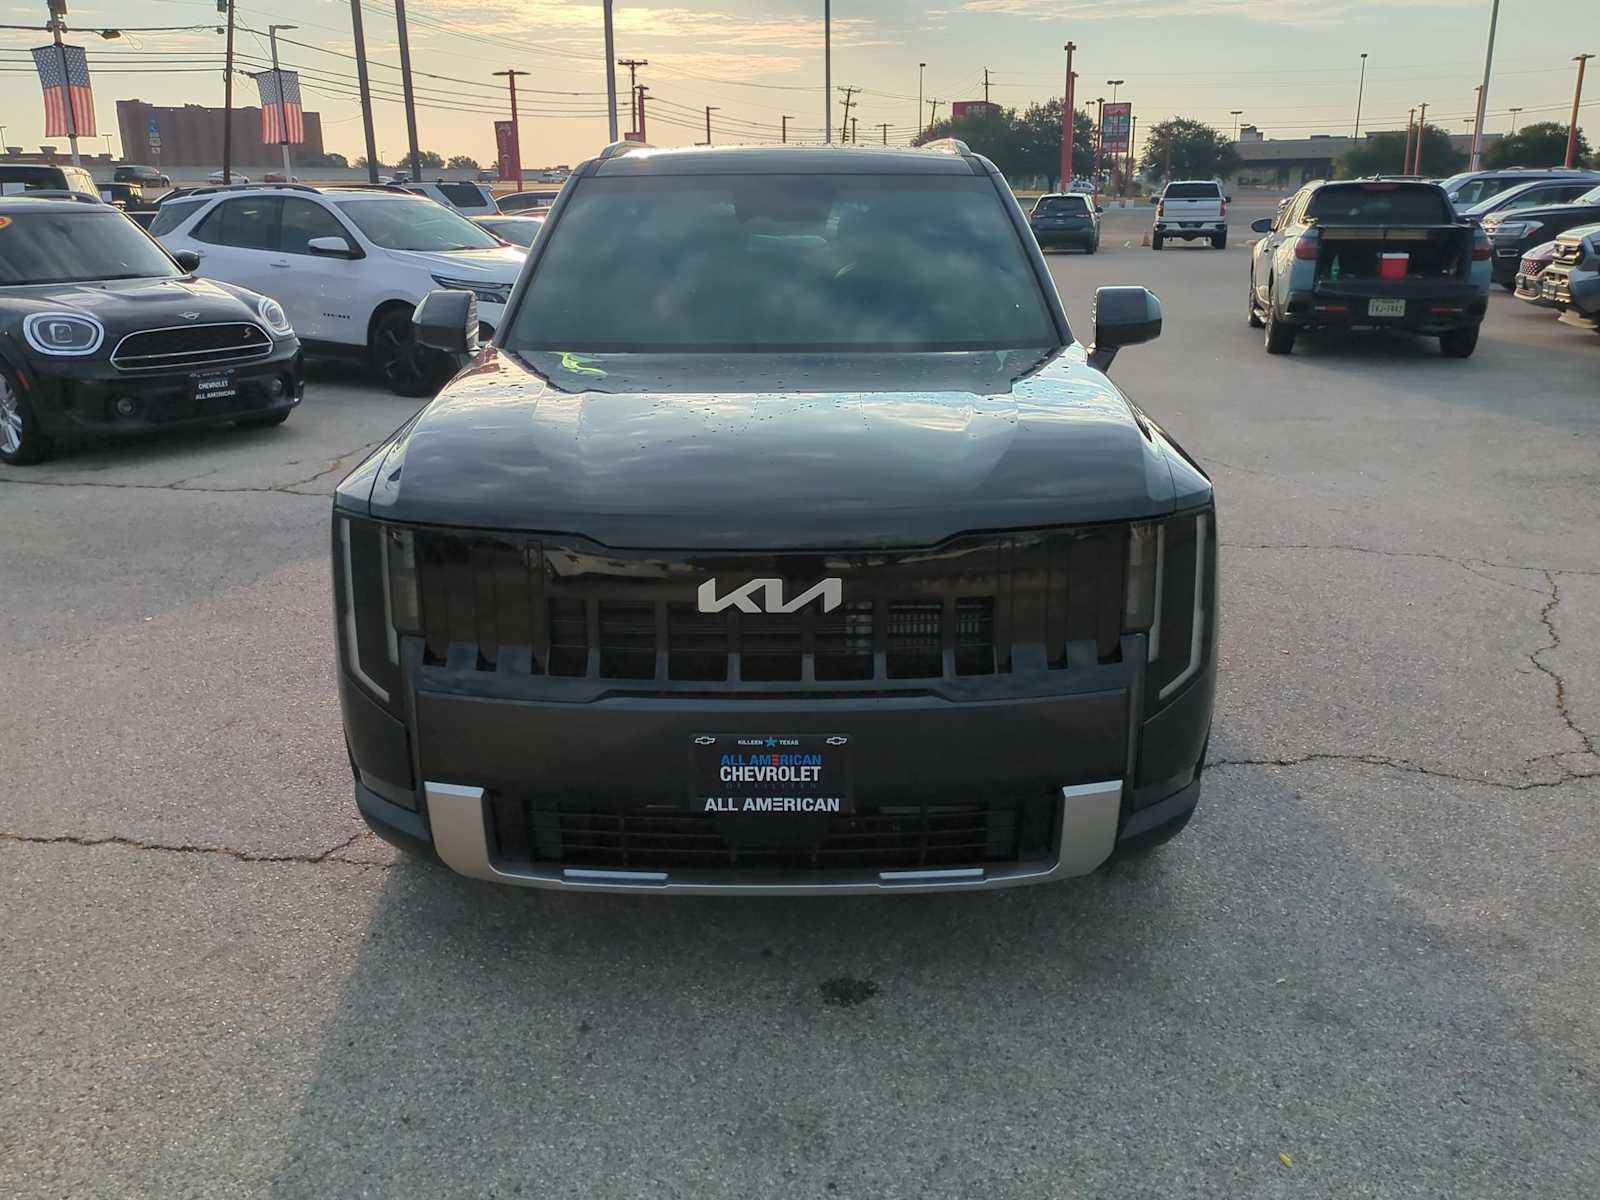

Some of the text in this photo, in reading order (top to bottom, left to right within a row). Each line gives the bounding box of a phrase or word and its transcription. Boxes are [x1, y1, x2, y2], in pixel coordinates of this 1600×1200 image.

[698, 577, 842, 613] KIA
[720, 753, 822, 767] ALL AMERICAN
[720, 766, 821, 782] CHEVROLET
[704, 798, 840, 812] ALL AMERICAN
